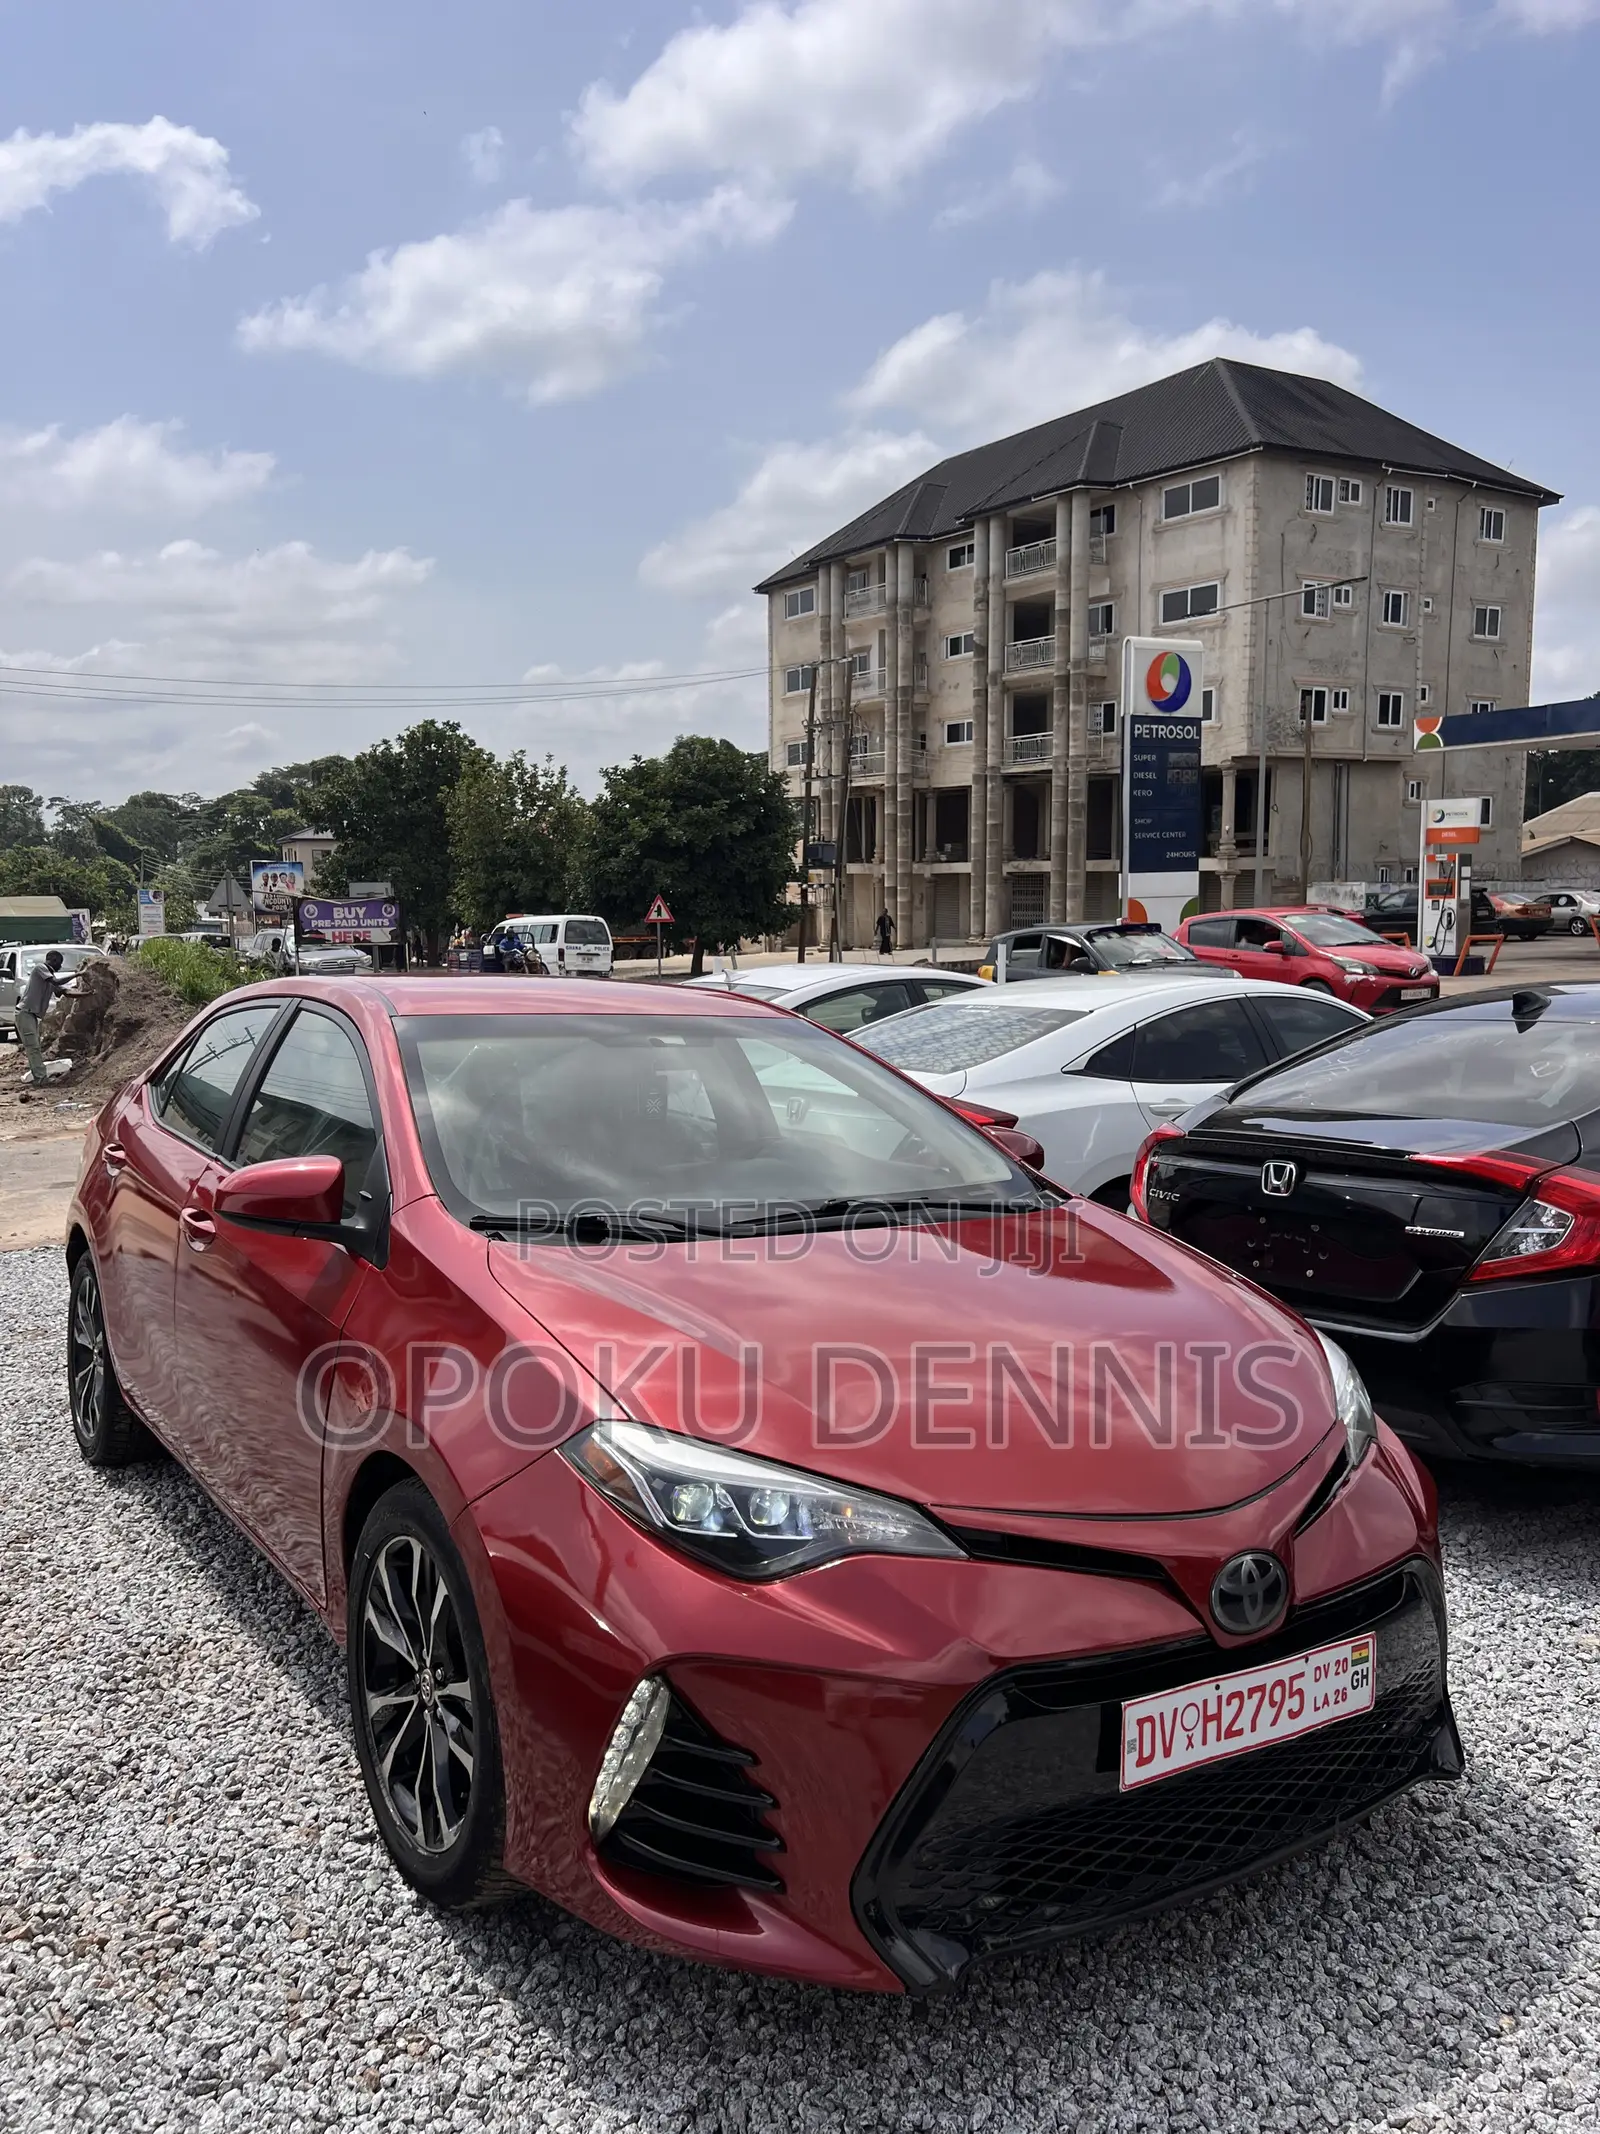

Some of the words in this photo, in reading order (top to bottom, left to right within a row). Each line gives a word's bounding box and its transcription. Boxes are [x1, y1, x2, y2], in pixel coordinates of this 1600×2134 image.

[1134, 724, 1199, 739] PETROSOL
[1133, 754, 1157, 762] SUPER
[1133, 772, 1157, 780] DIESEL
[1133, 789, 1153, 797] KERO
[1134, 831, 1160, 839] SERVICE
[1161, 831, 1187, 839] CENTER
[1166, 851, 1197, 859] 24HOURS
[333, 907, 366, 919] BUY
[311, 919, 358, 928] PRE-PAID
[360, 919, 390, 927] UNITS
[1149, 1188, 1180, 1202] CIVIC
[1314, 1664, 1331, 1683] DV
[1334, 1657, 1349, 1676] 20
[1350, 1667, 1369, 1691] GH
[1313, 1692, 1330, 1713] LA
[1333, 1686, 1348, 1705] 26
